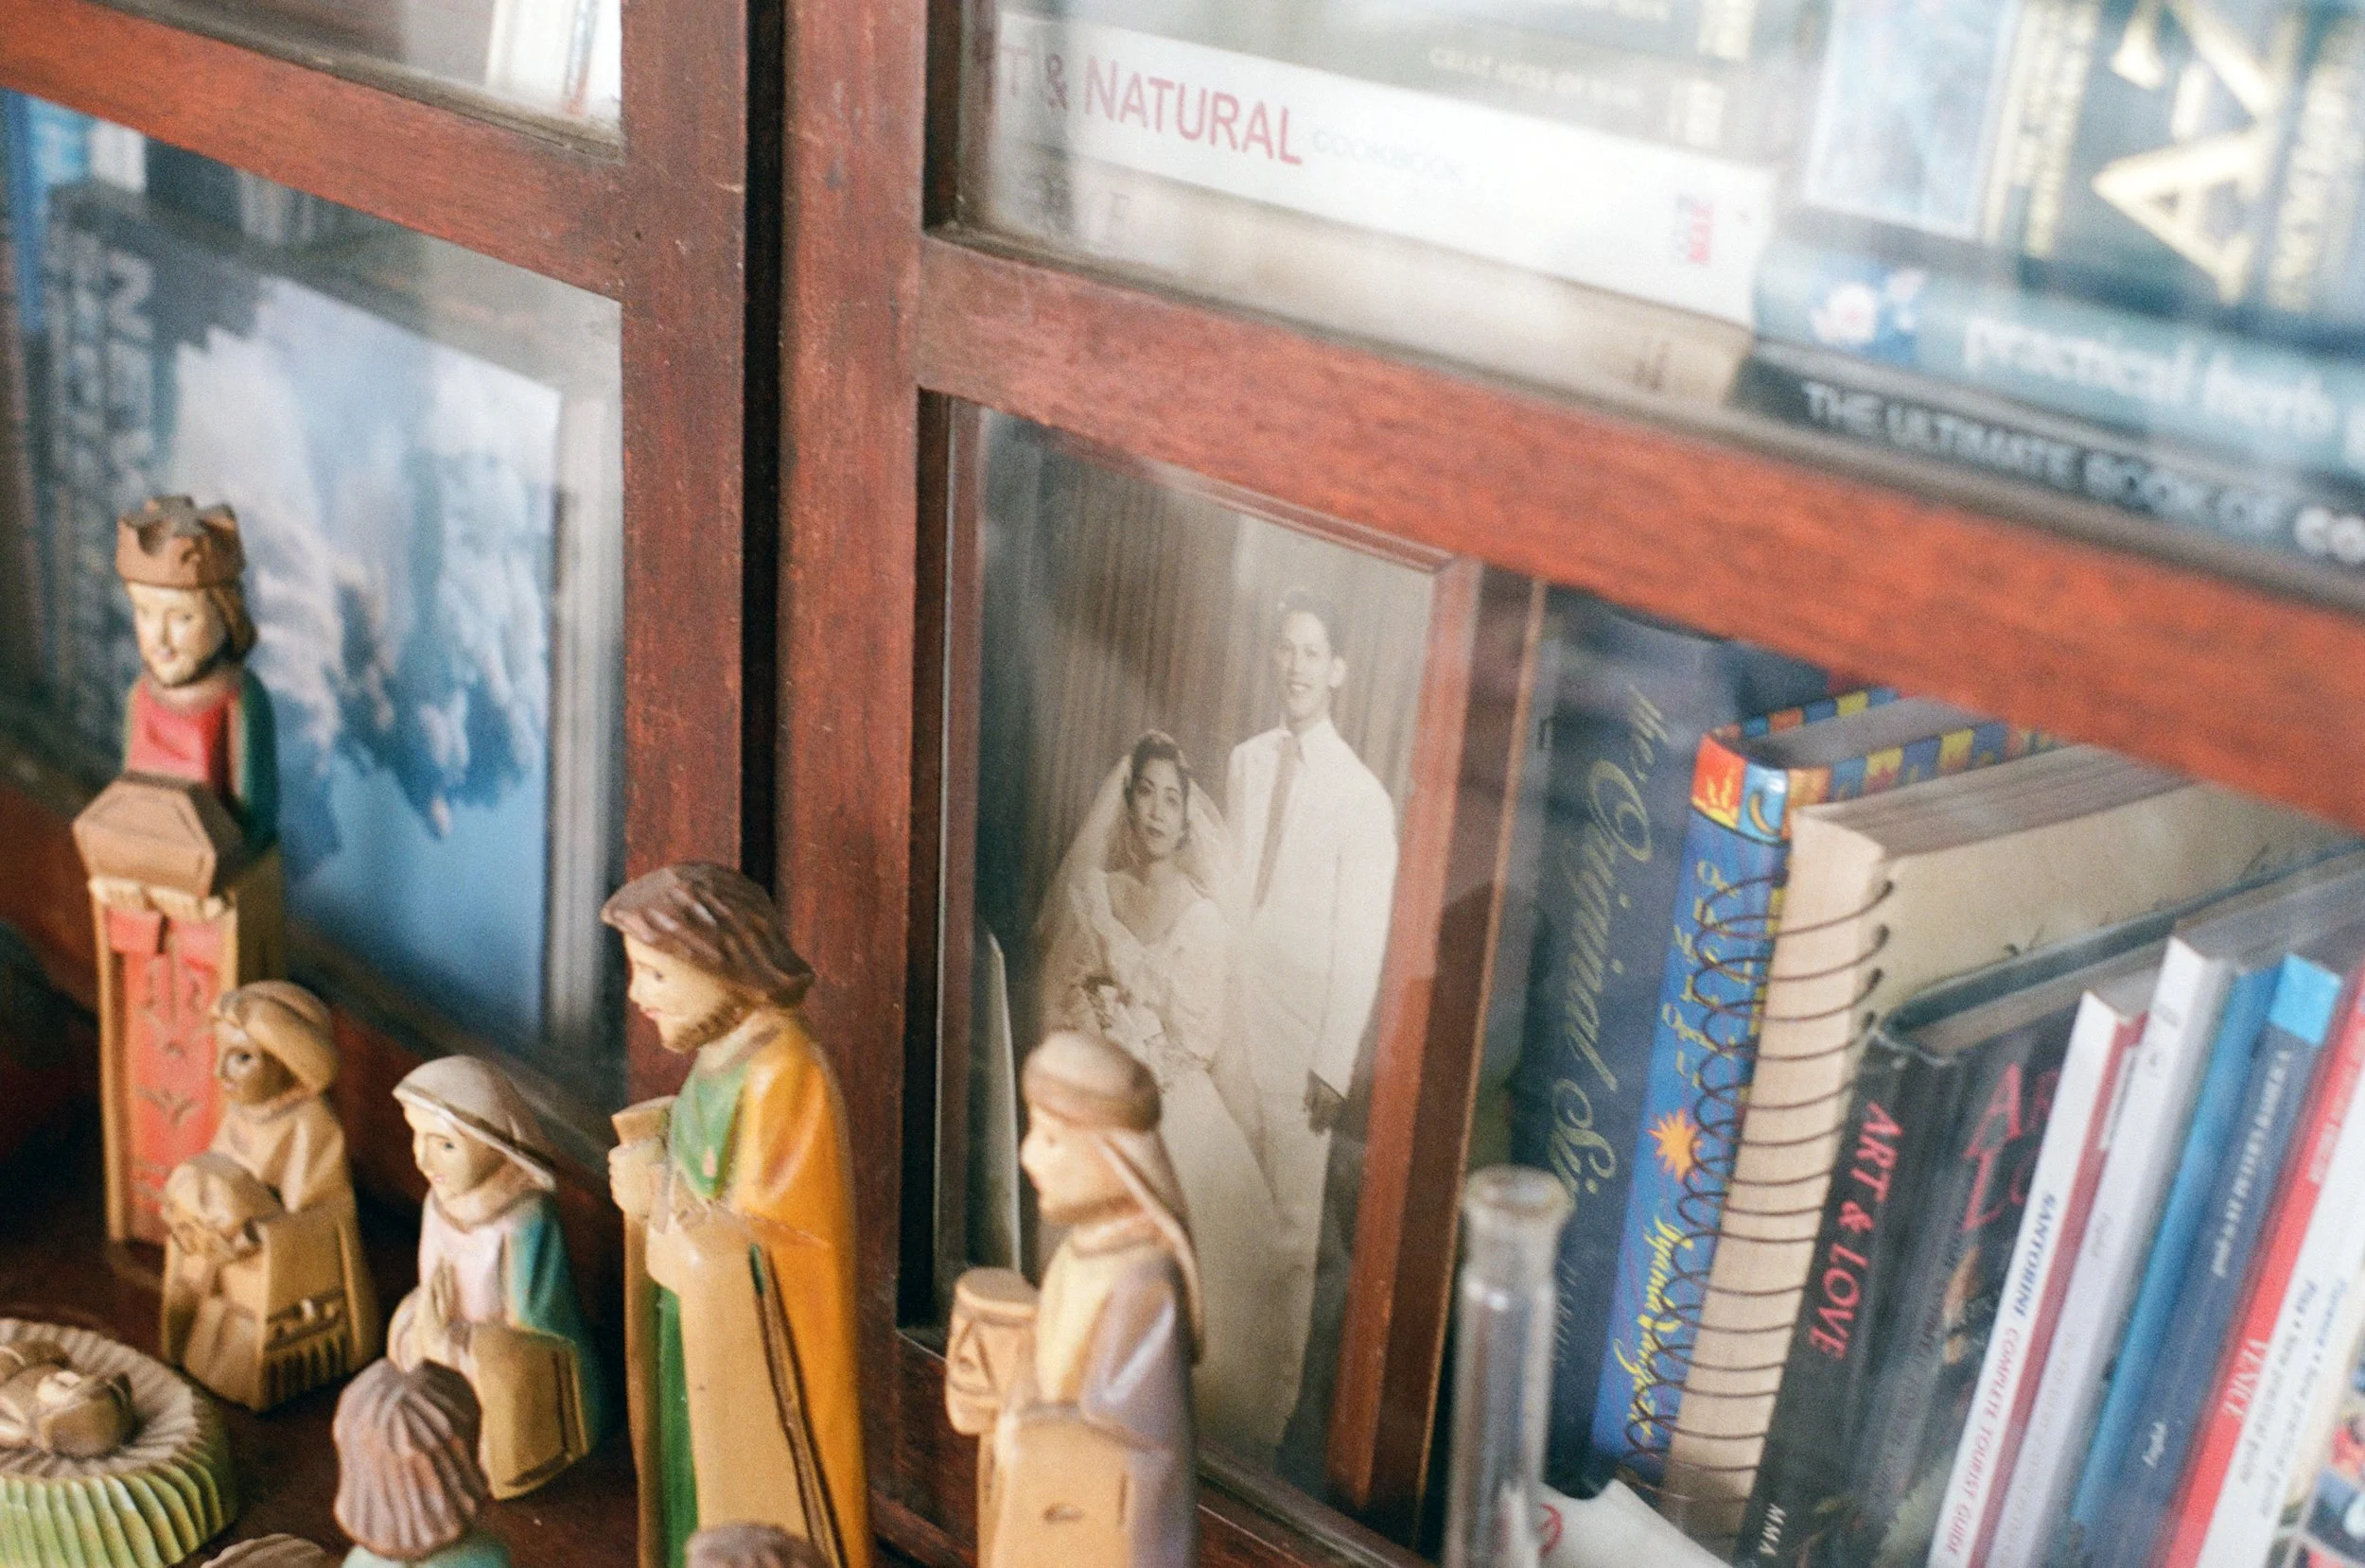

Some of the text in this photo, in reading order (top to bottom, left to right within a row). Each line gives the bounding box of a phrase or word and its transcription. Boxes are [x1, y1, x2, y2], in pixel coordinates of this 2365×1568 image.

[1045, 53, 1068, 111] &
[1085, 56, 1302, 166] NATURAL
[1313, 128, 1463, 184] COOKBOOK
[1801, 380, 1882, 437] THE
[1886, 401, 2076, 489] ULTIMATE
[2083, 445, 2212, 522] BOOK
[2215, 487, 2279, 538] OF
[1564, 759, 1653, 1092] Original
[1809, 1101, 1903, 1360] ART & LOVE
[1944, 1192, 2057, 1556] SANTORINI COMPLETE TOURIST GUIDE
